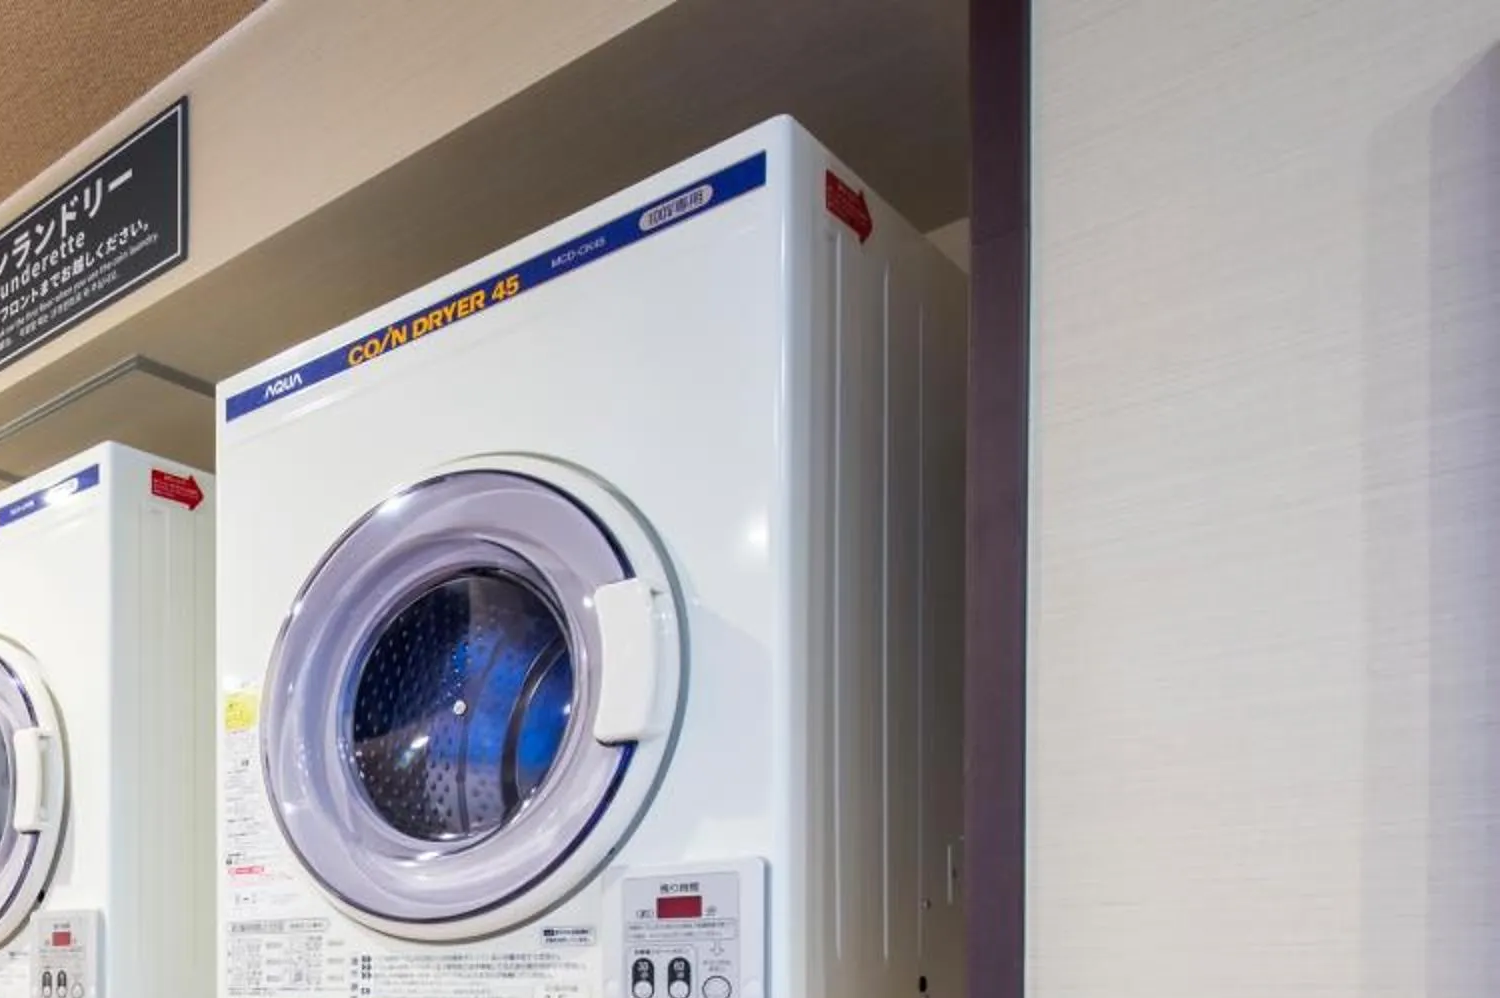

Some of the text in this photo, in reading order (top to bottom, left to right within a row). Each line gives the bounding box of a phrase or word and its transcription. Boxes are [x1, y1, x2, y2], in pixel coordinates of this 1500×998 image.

[264, 374, 303, 398] AQUA
[411, 288, 486, 342] DRYER
[491, 273, 520, 302] 45
